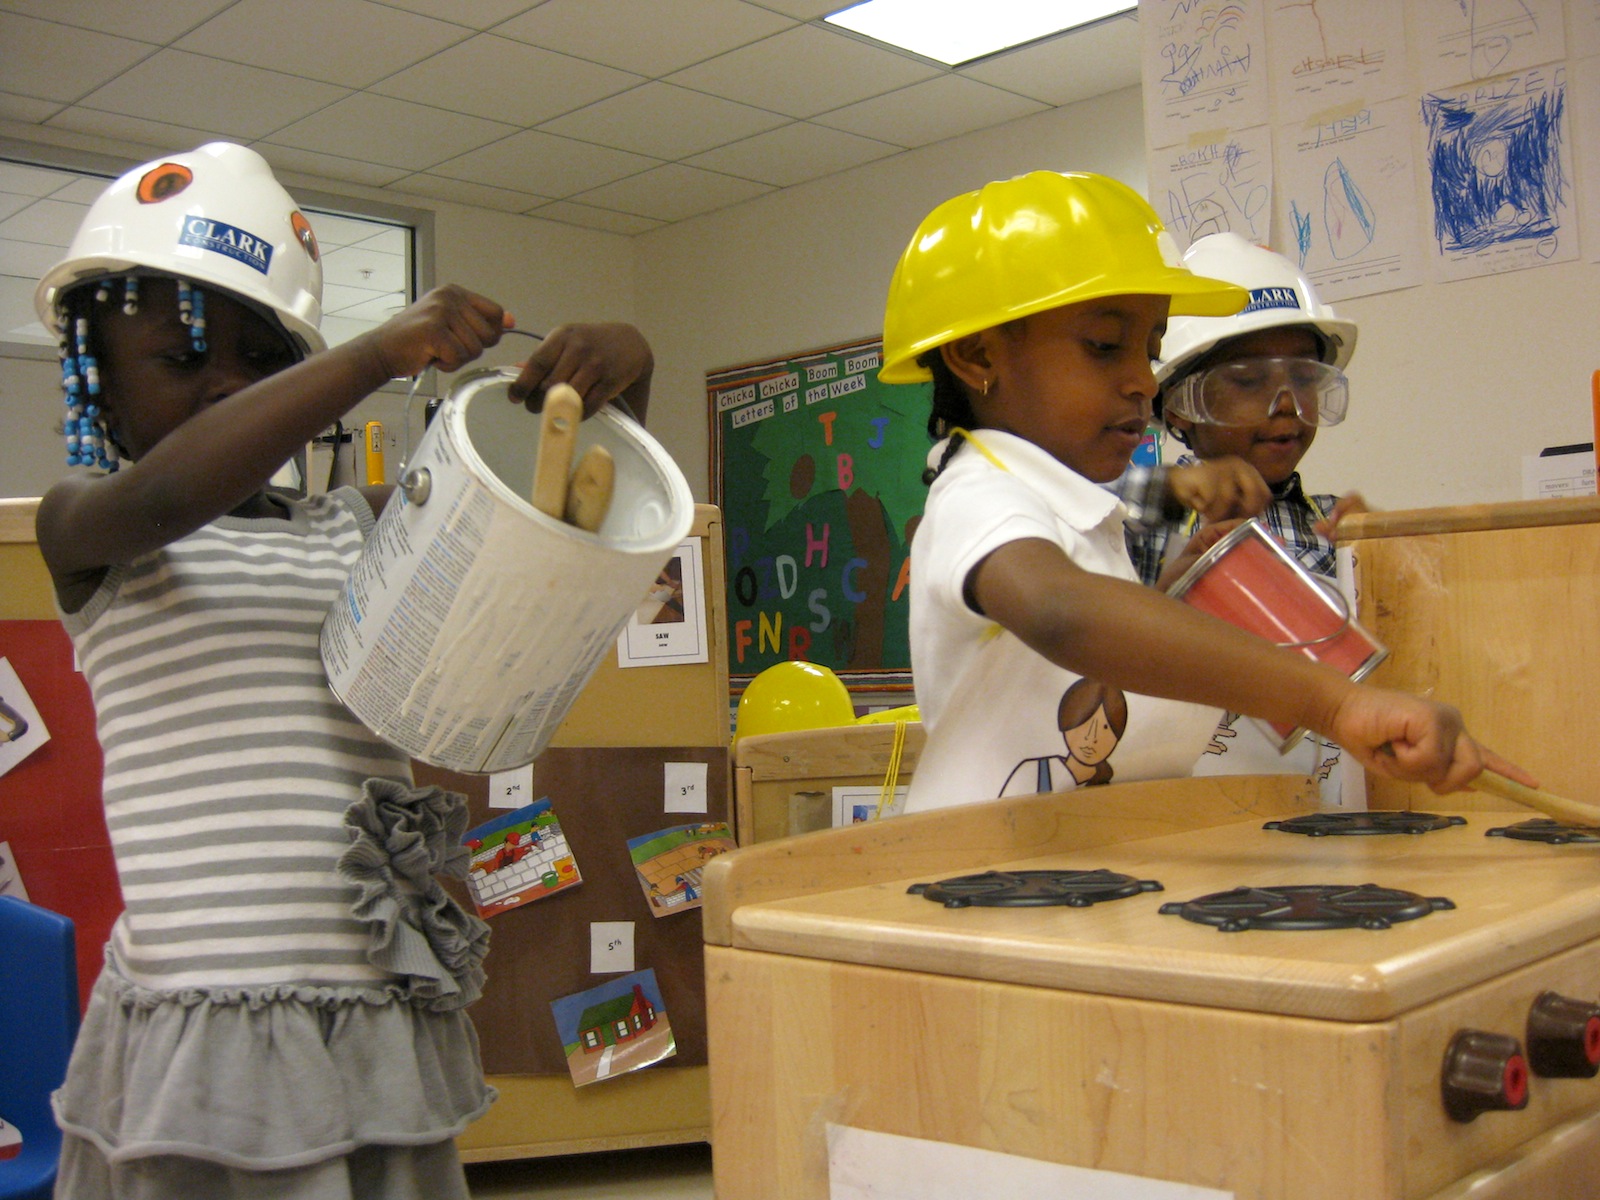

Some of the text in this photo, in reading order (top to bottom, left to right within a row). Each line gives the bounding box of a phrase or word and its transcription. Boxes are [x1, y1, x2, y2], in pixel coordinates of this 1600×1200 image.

[187, 219, 268, 262] CLARK
[1248, 288, 1294, 305] LARK
[720, 355, 878, 407] Chicka Chicka Boom Boom
[734, 376, 864, 426] Letters of the Week
[818, 411, 837, 446] T
[867, 417, 890, 449] J
[837, 453, 854, 490] B
[731, 527, 750, 566] P
[804, 523, 830, 569] H
[734, 566, 758, 607] O
[776, 554, 798, 600] D
[842, 558, 868, 603] C
[808, 588, 831, 633] S
[655, 632, 669, 640] SAW
[735, 620, 752, 664] F
[758, 611, 782, 654] N
[788, 626, 812, 662] R
[681, 784, 695, 796] 3rd
[608, 938, 622, 951] 5th
